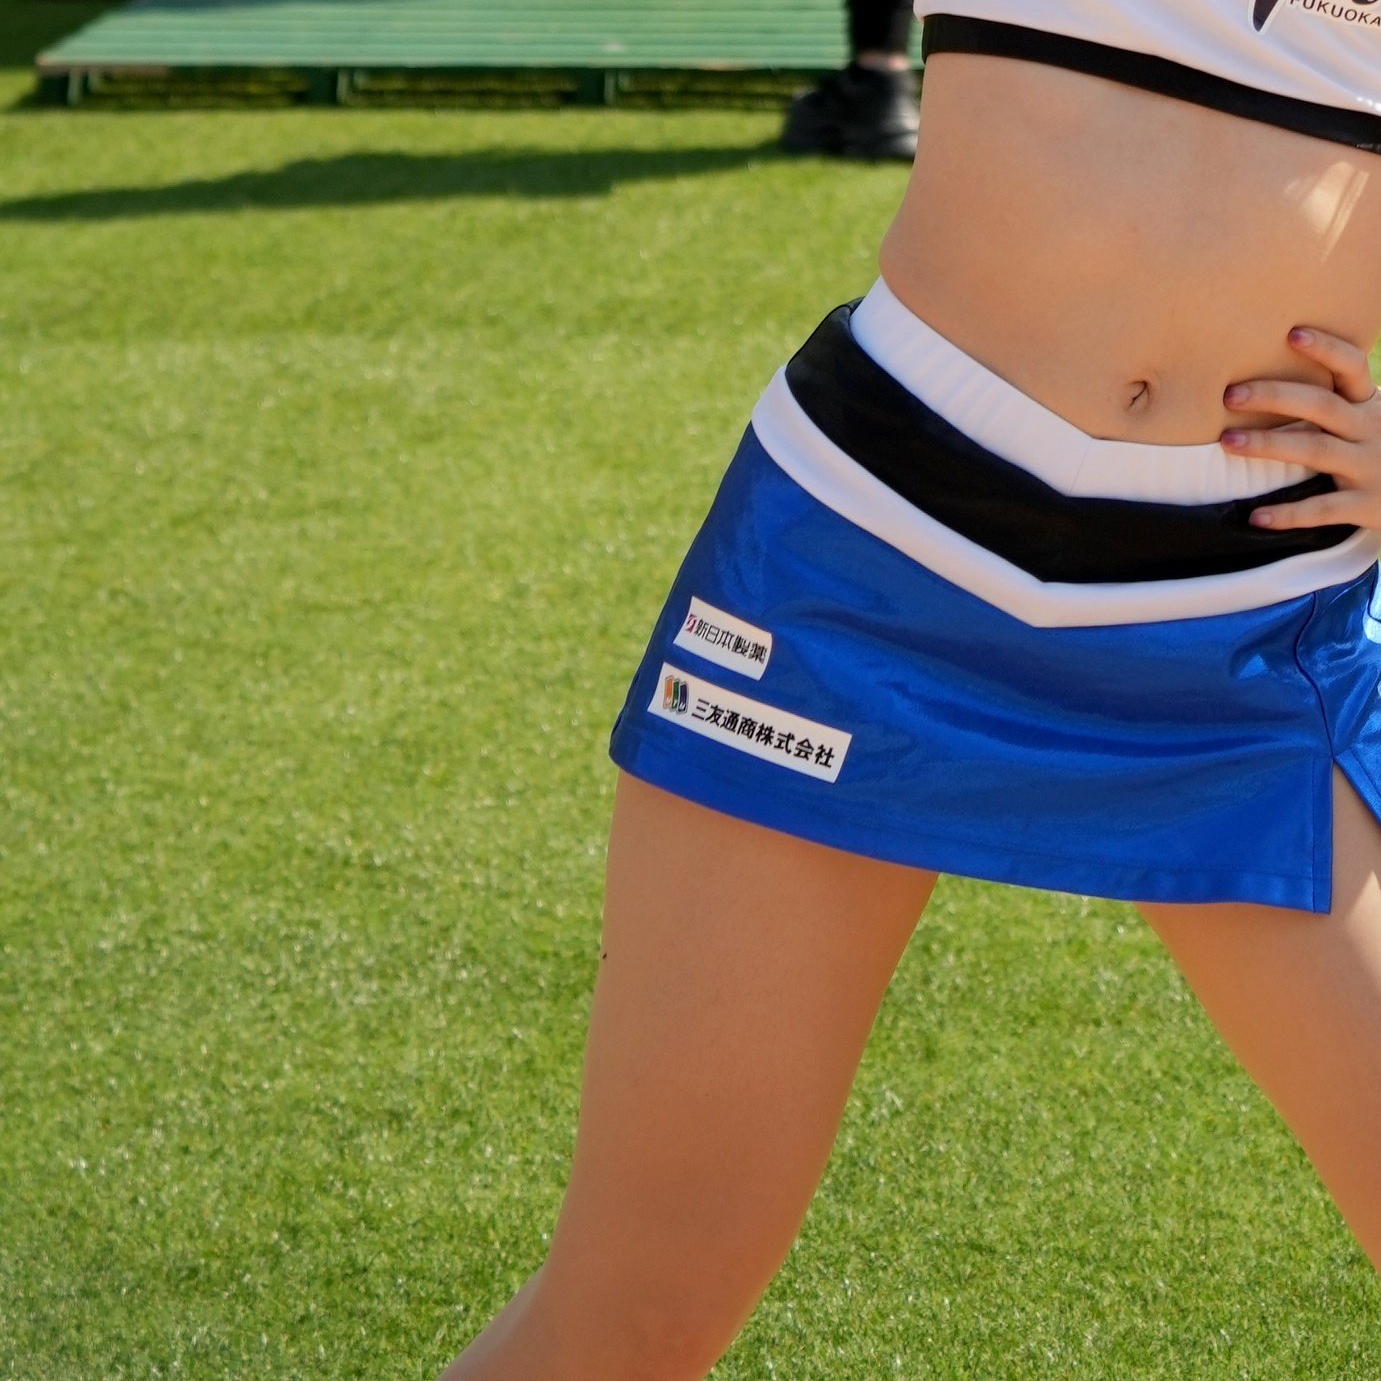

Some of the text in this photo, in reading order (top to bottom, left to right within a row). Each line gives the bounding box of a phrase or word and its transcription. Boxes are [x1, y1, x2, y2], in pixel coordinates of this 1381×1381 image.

[694, 619, 768, 665] 新日本製薬
[692, 698, 836, 769] 三友通商株式会社
